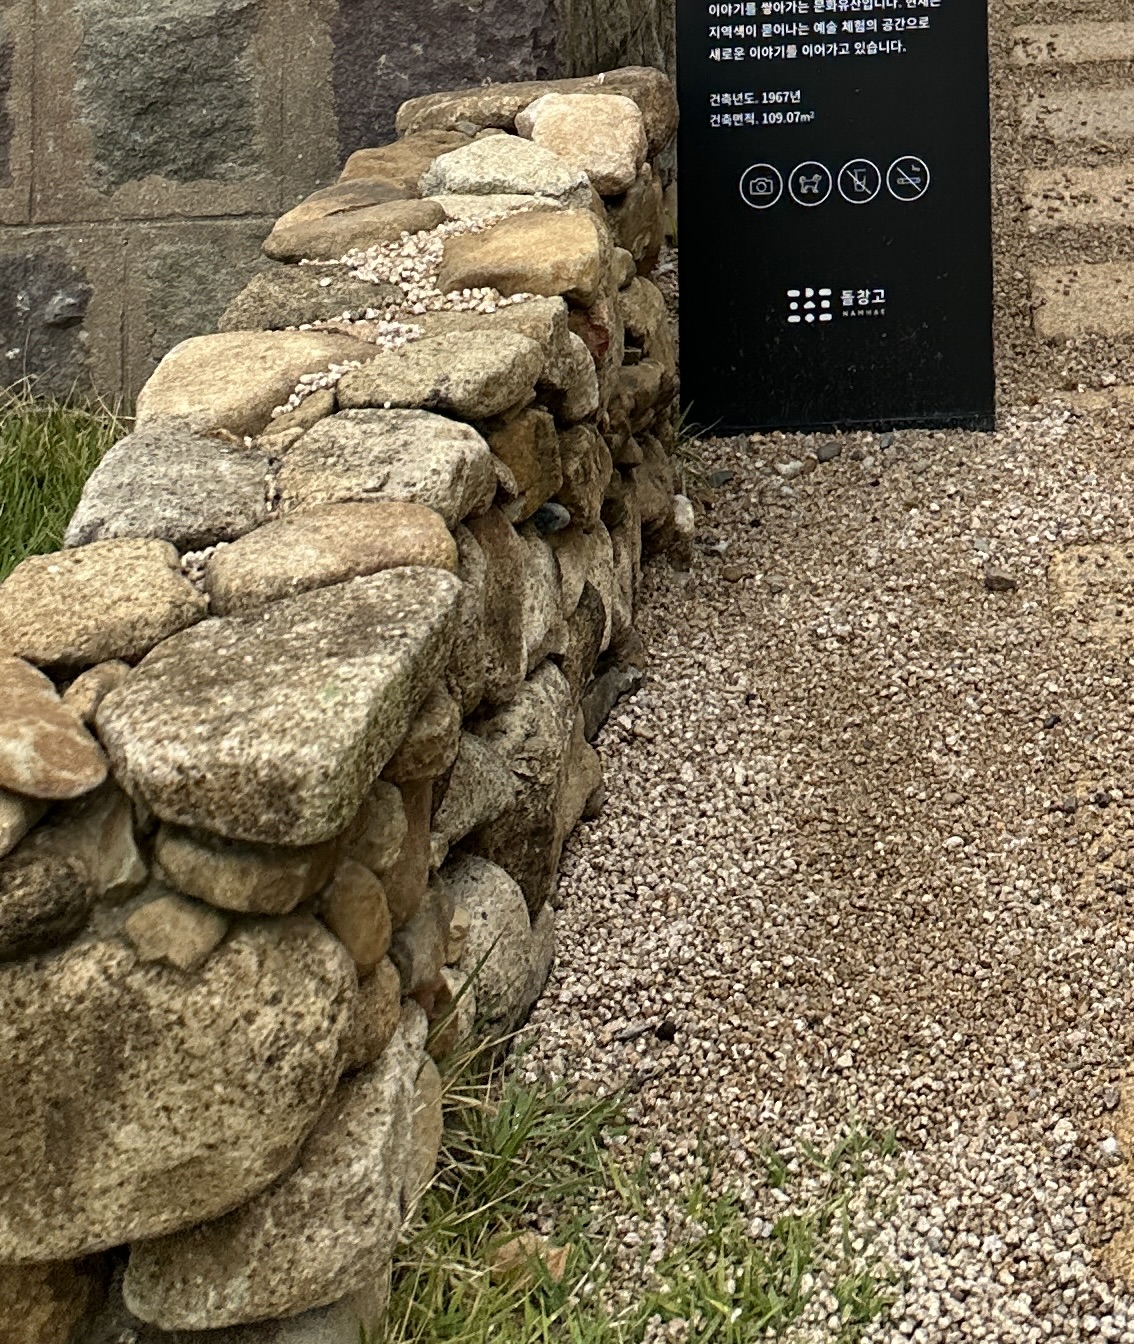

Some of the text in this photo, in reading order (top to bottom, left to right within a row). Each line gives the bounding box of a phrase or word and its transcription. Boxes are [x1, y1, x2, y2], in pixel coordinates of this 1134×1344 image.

[708, 0, 757, 18] 이야기를
[708, 23, 757, 40] 지역색이
[813, 19, 838, 35] 예술
[841, 17, 878, 34] 체험의
[881, 15, 930, 33] 공간으로
[708, 38, 907, 63] 새로운 이야기를 이어가고 있습니다.
[709, 88, 801, 108] 건축년도. 1967년
[709, 111, 759, 128] 건축면적.
[840, 288, 886, 307] 돌창고
